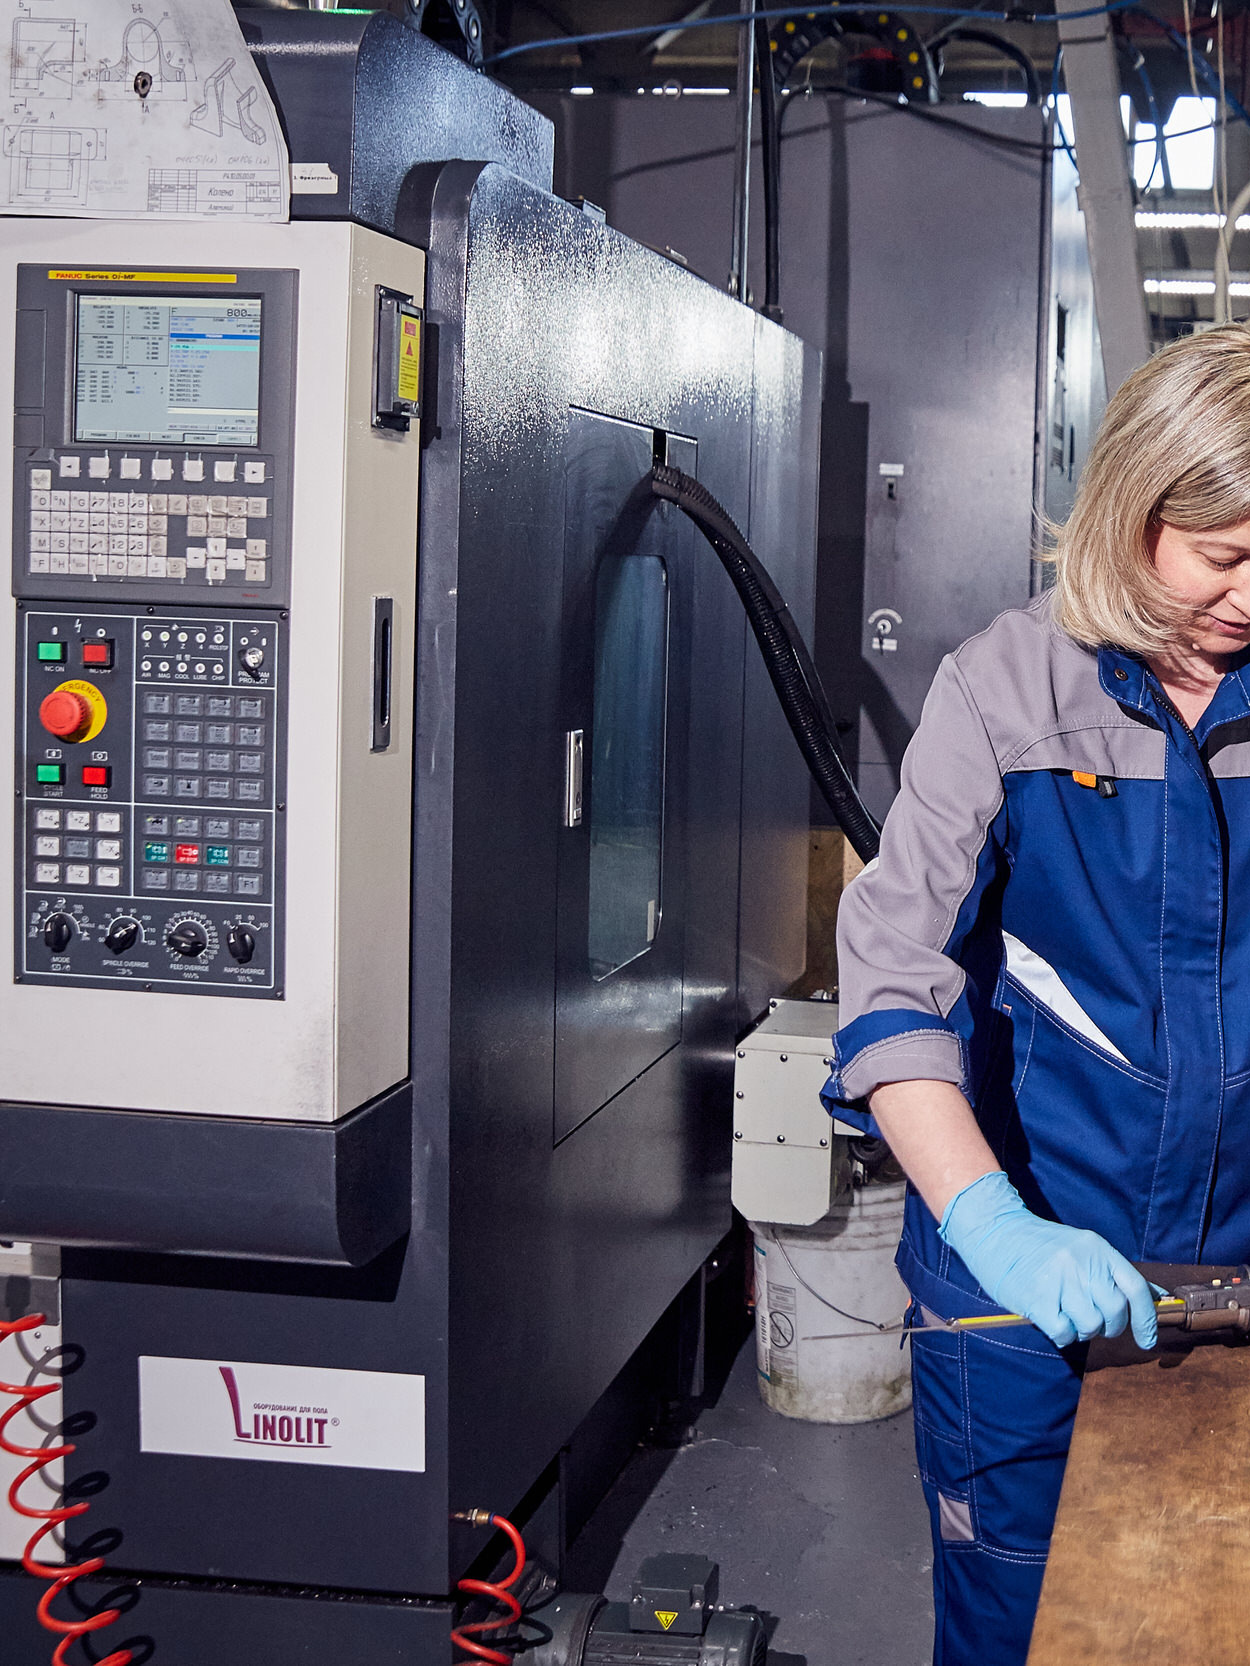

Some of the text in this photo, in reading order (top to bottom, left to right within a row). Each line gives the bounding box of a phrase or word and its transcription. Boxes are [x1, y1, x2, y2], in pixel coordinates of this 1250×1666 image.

[227, 308, 248, 317] 800
[62, 682, 102, 702] ERGENCY
[244, 880, 254, 888] F1
[184, 964, 209, 972] OVERRIDE
[218, 1366, 328, 1444] LINOLIT
[253, 1402, 329, 1415] ОБОРУДОВАНИЕ ДЛЯ ПОЛА
